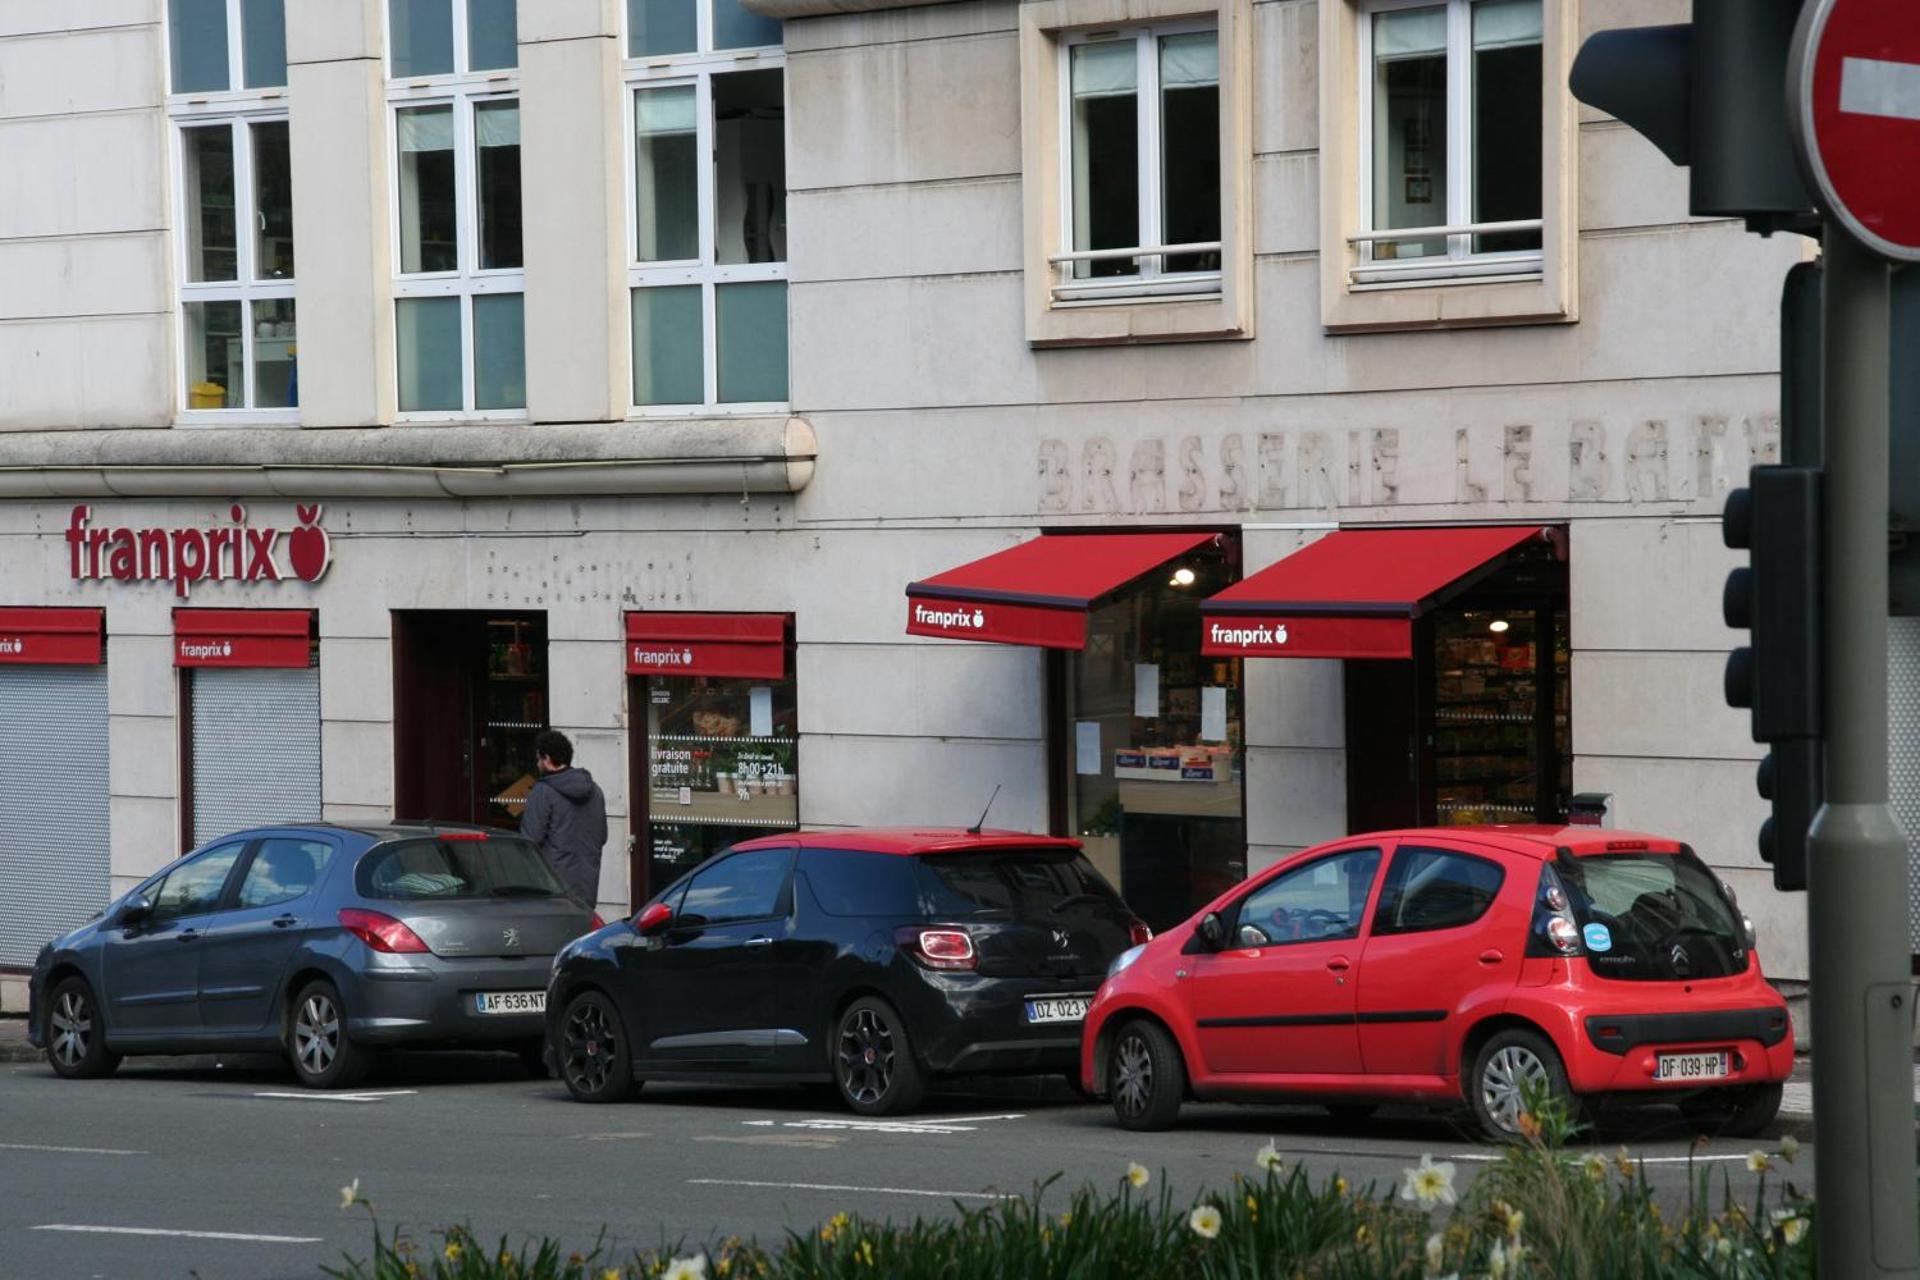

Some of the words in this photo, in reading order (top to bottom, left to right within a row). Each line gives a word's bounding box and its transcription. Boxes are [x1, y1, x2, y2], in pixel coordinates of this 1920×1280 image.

[1037, 428, 1399, 514] BRASSERIE
[1455, 424, 1533, 502] LE
[66, 503, 282, 598] franprix
[915, 604, 971, 631] franprix
[1211, 624, 1273, 648] franprix
[180, 641, 222, 660] franprix
[634, 647, 681, 667] franprix
[651, 746, 690, 760] livraison
[651, 760, 688, 777] gratuite
